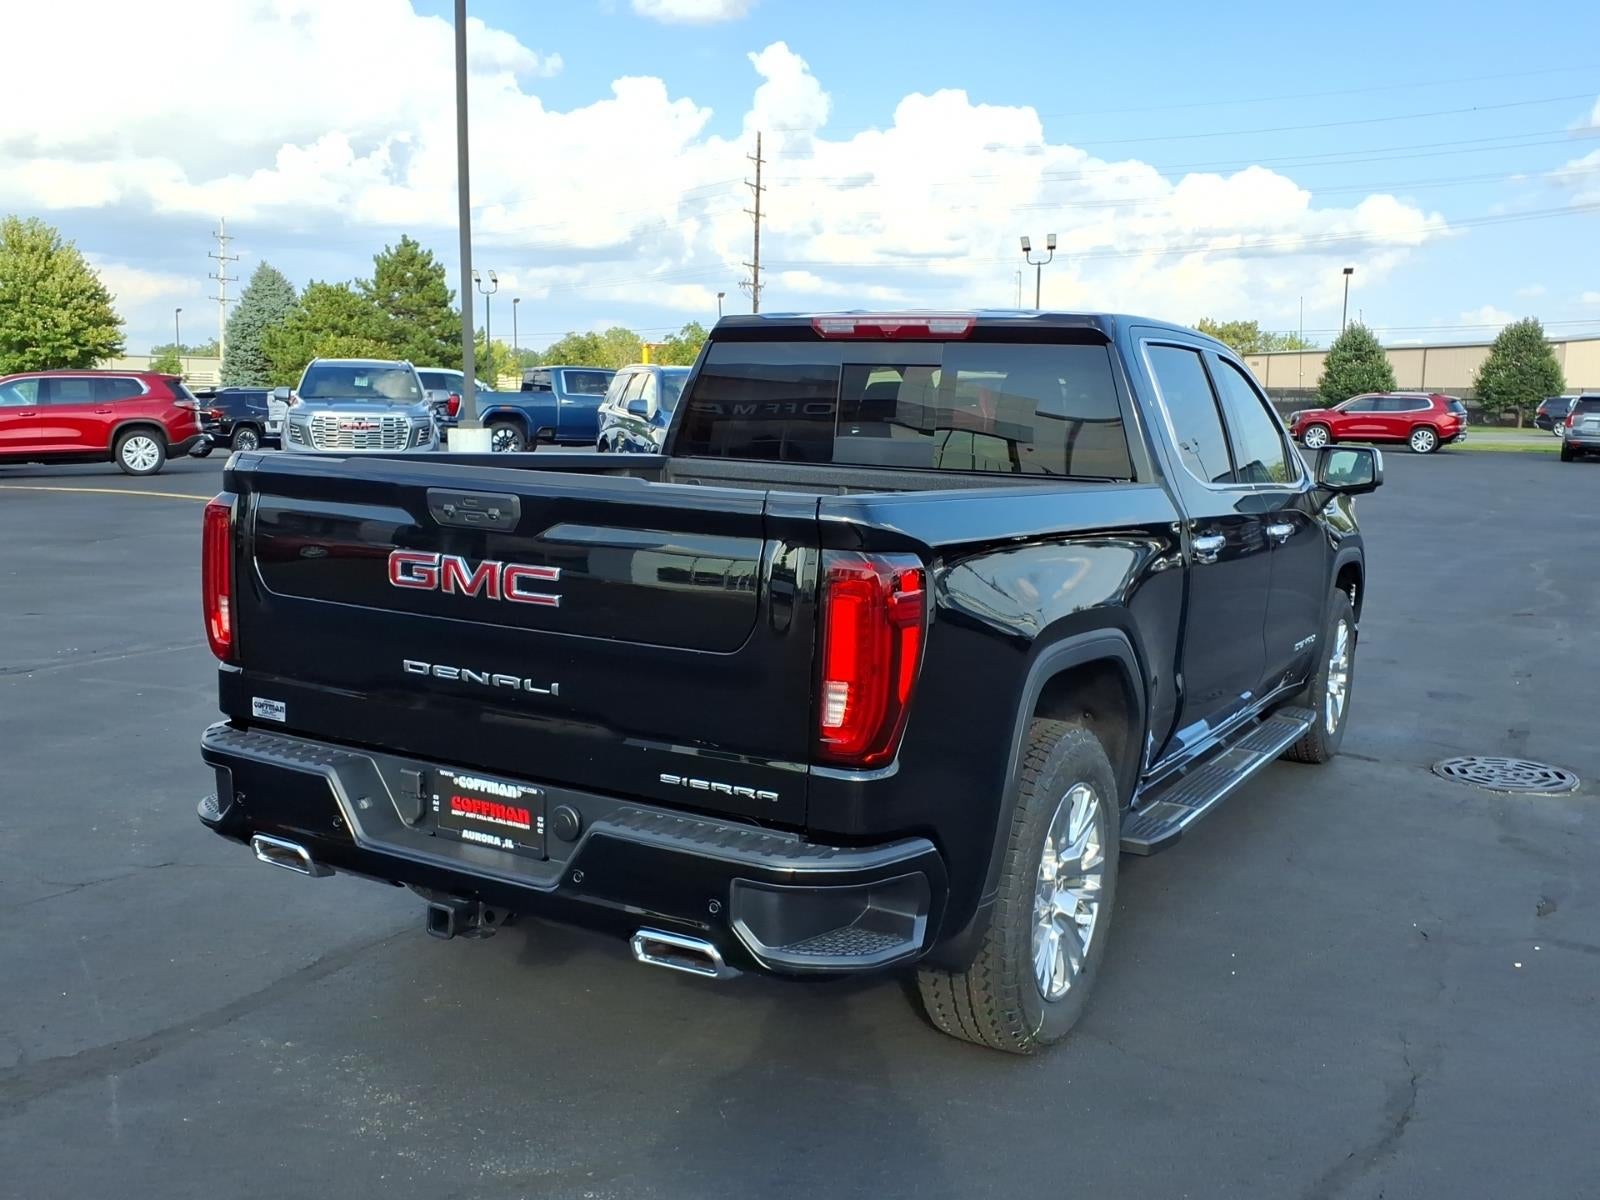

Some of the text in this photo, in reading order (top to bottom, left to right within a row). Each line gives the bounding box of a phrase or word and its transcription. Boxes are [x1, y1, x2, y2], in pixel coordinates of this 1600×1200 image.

[388, 549, 562, 607] GMC
[403, 659, 560, 696] DENALI
[458, 775, 518, 799] COFFMAN
[659, 773, 779, 802] SIERRA
[451, 795, 531, 824] COFFMAN
[462, 829, 501, 846] AURORA
